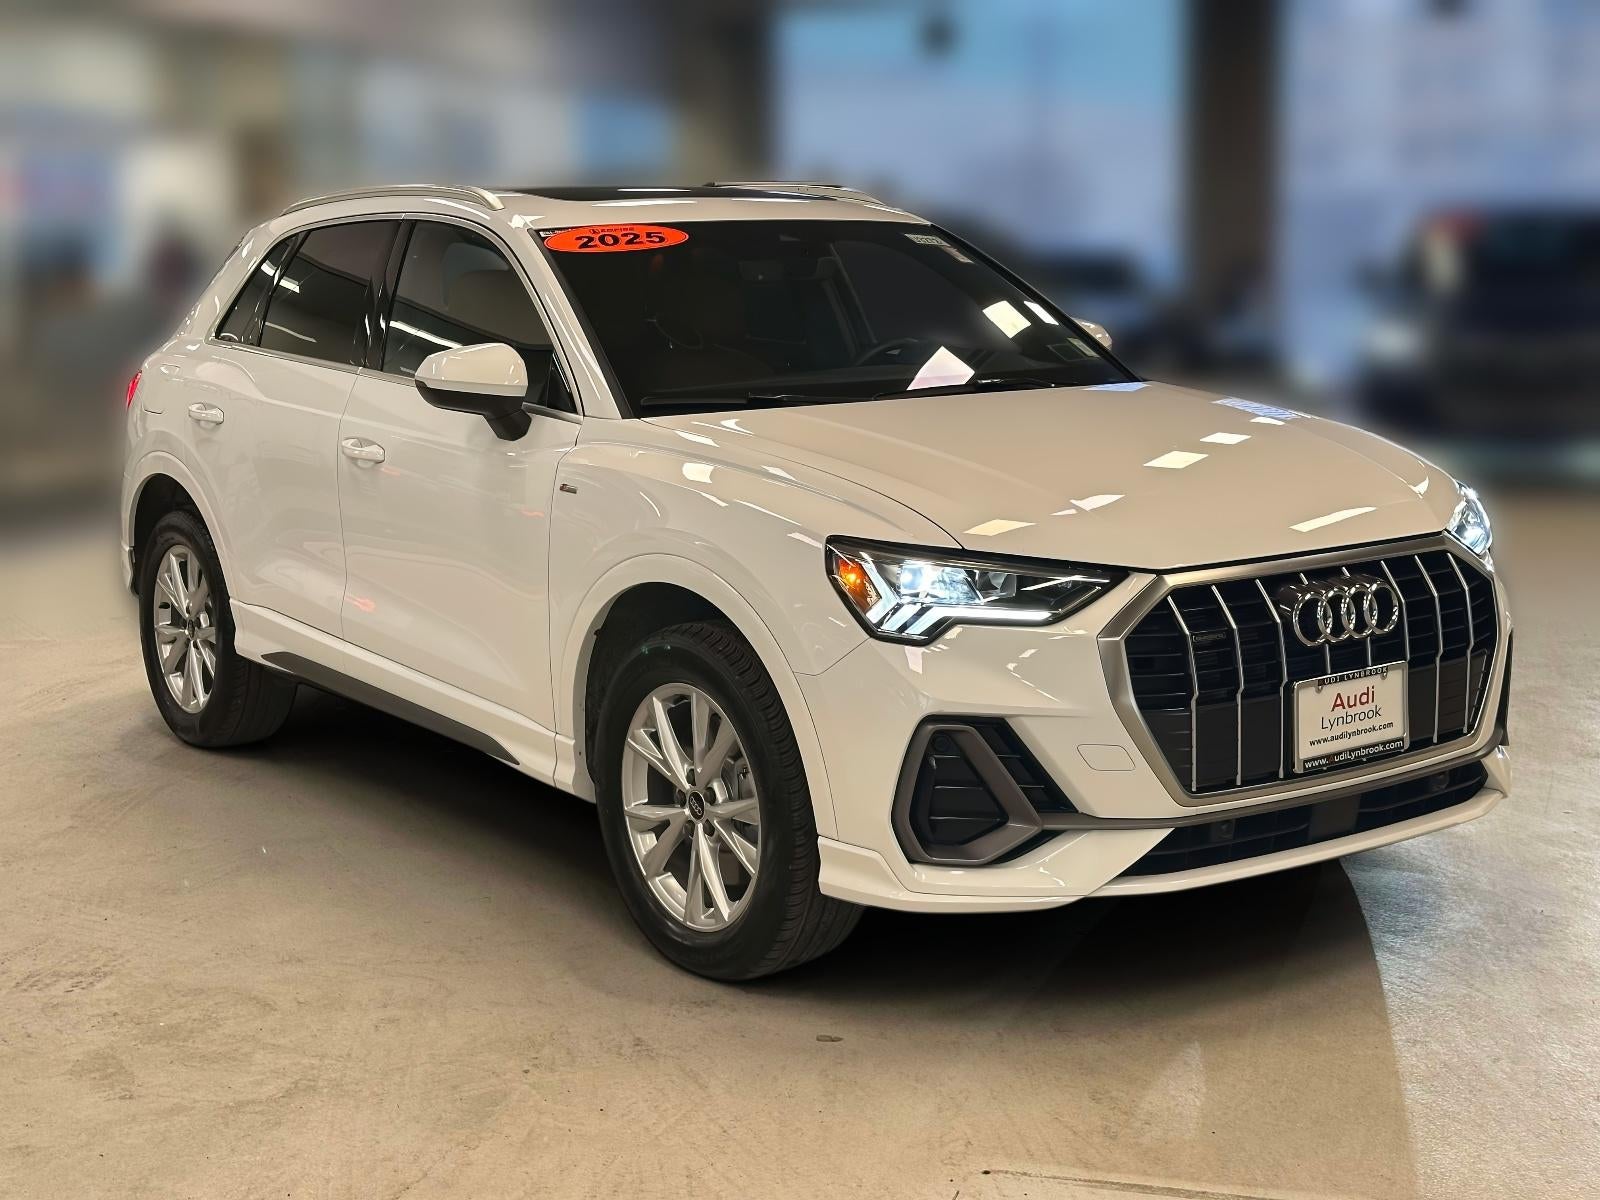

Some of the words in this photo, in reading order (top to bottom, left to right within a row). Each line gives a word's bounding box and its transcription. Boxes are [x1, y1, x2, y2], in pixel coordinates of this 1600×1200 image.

[574, 231, 666, 249] 2025
[1344, 666, 1388, 681] LYNBROOK
[1331, 685, 1375, 712] Audi
[1321, 705, 1382, 731] Lynbrook
[1309, 721, 1394, 747] www.audilynbrook.com
[1304, 740, 1404, 769] www.AudiLynbrook.com
